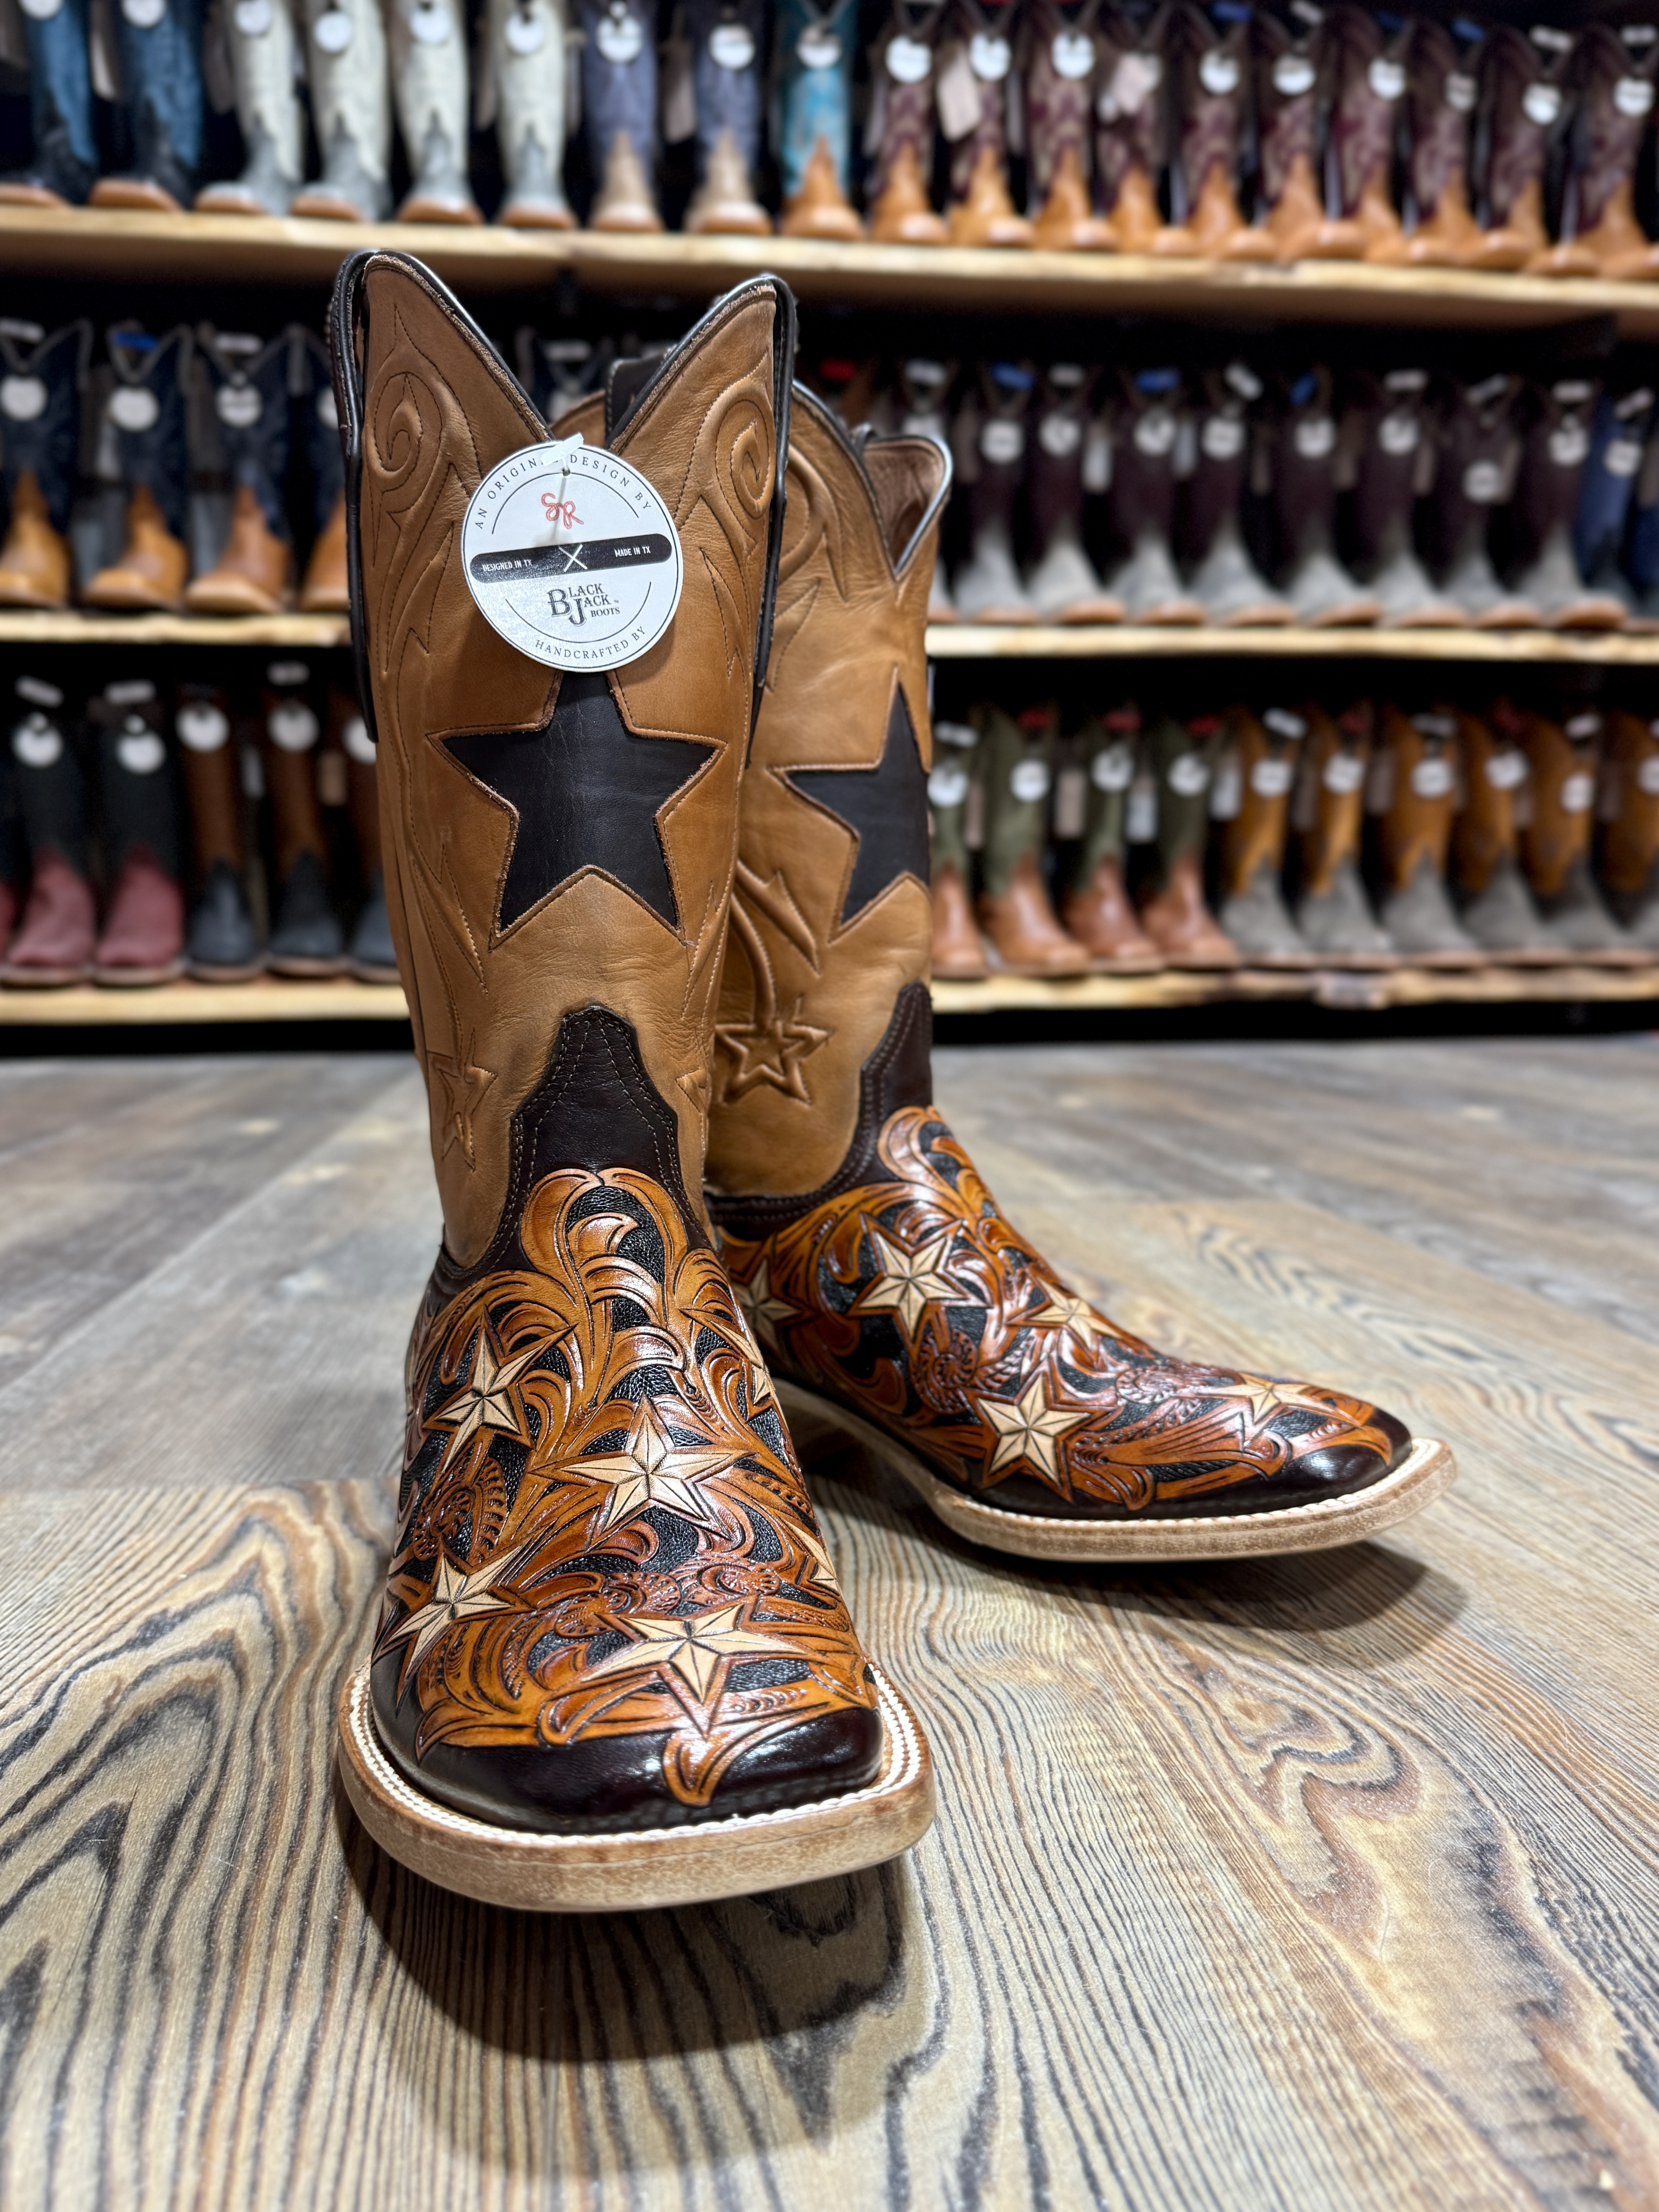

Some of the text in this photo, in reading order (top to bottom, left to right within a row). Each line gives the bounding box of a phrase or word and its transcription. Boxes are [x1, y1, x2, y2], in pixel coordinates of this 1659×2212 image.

[475, 454, 651, 529] AN ORIGIN DESIGN BY
[482, 562, 513, 572] DESIGNED
[514, 560, 522, 568] IN
[614, 545, 651, 557] MADE IN TX
[547, 583, 605, 618] BLACK
[568, 594, 612, 627] JACK
[590, 607, 620, 618] BOOTS
[535, 626, 645, 659] HANDCRAFTED BY
